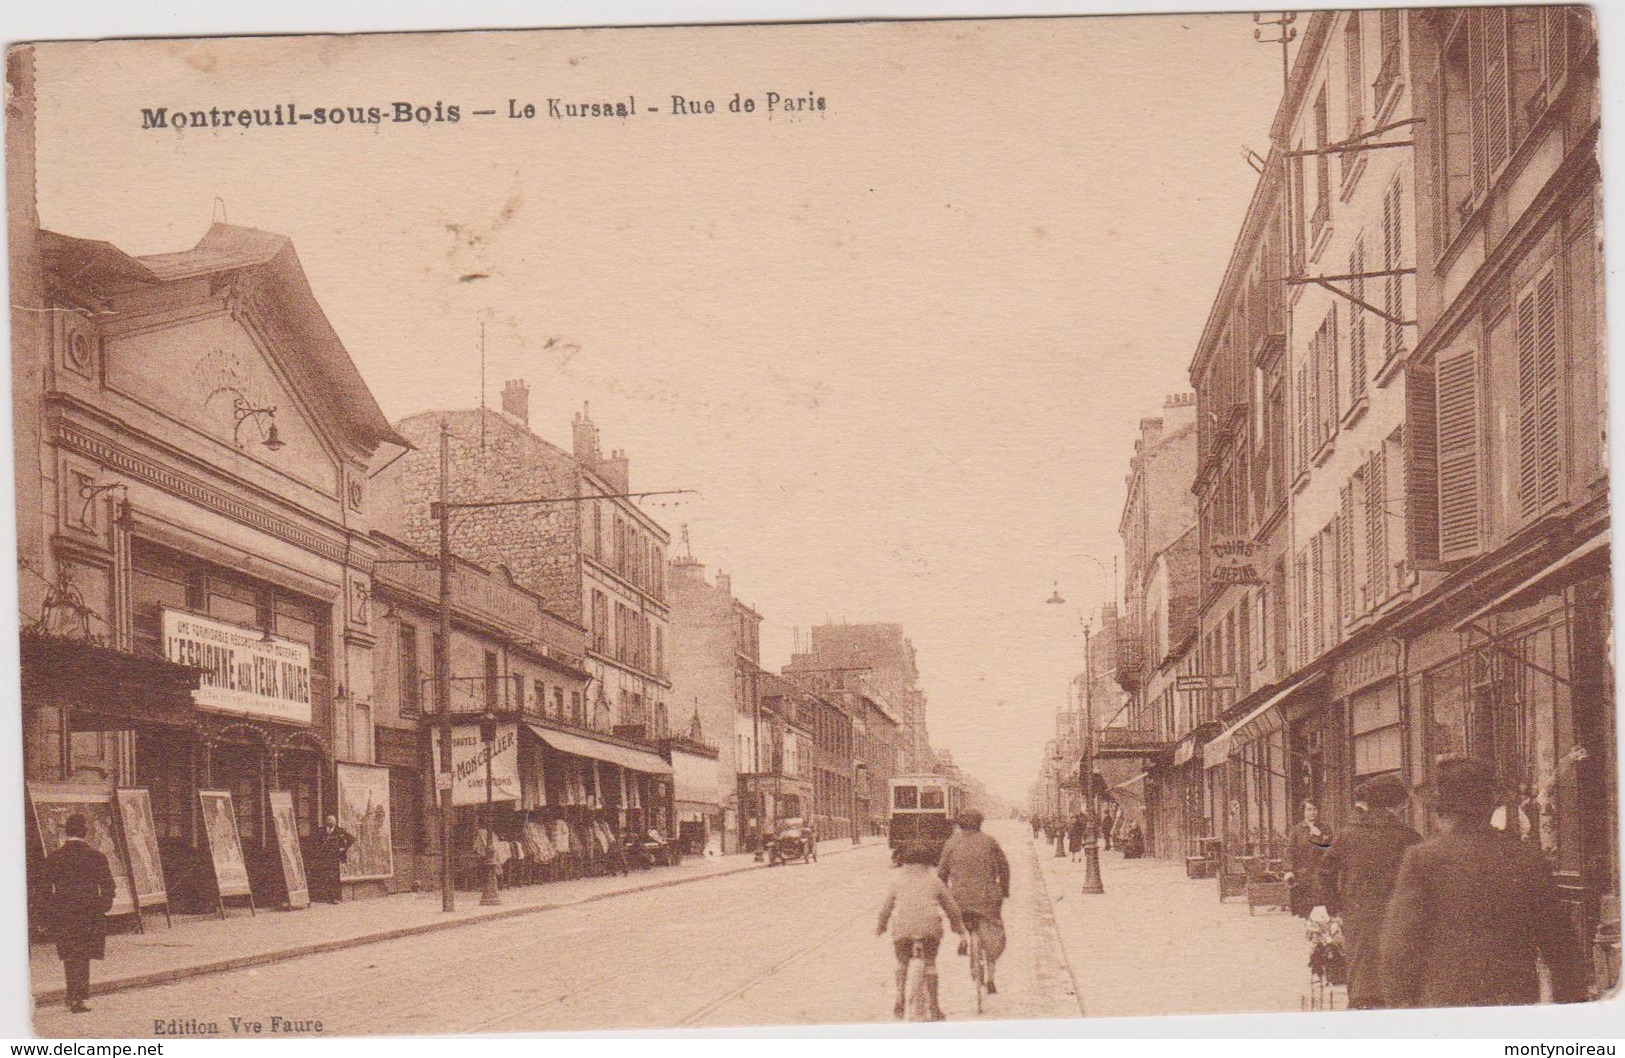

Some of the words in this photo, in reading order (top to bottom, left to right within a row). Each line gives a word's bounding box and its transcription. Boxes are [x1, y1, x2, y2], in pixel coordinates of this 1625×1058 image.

[177, 620, 190, 635] UNE
[192, 623, 229, 645] FORMIDABLE
[168, 636, 235, 690] L'ESPIONNE
[238, 663, 253, 694] AUX
[253, 654, 279, 698] YEUX
[281, 661, 309, 704] NOIRS
[456, 731, 514, 781] MONCELIER
